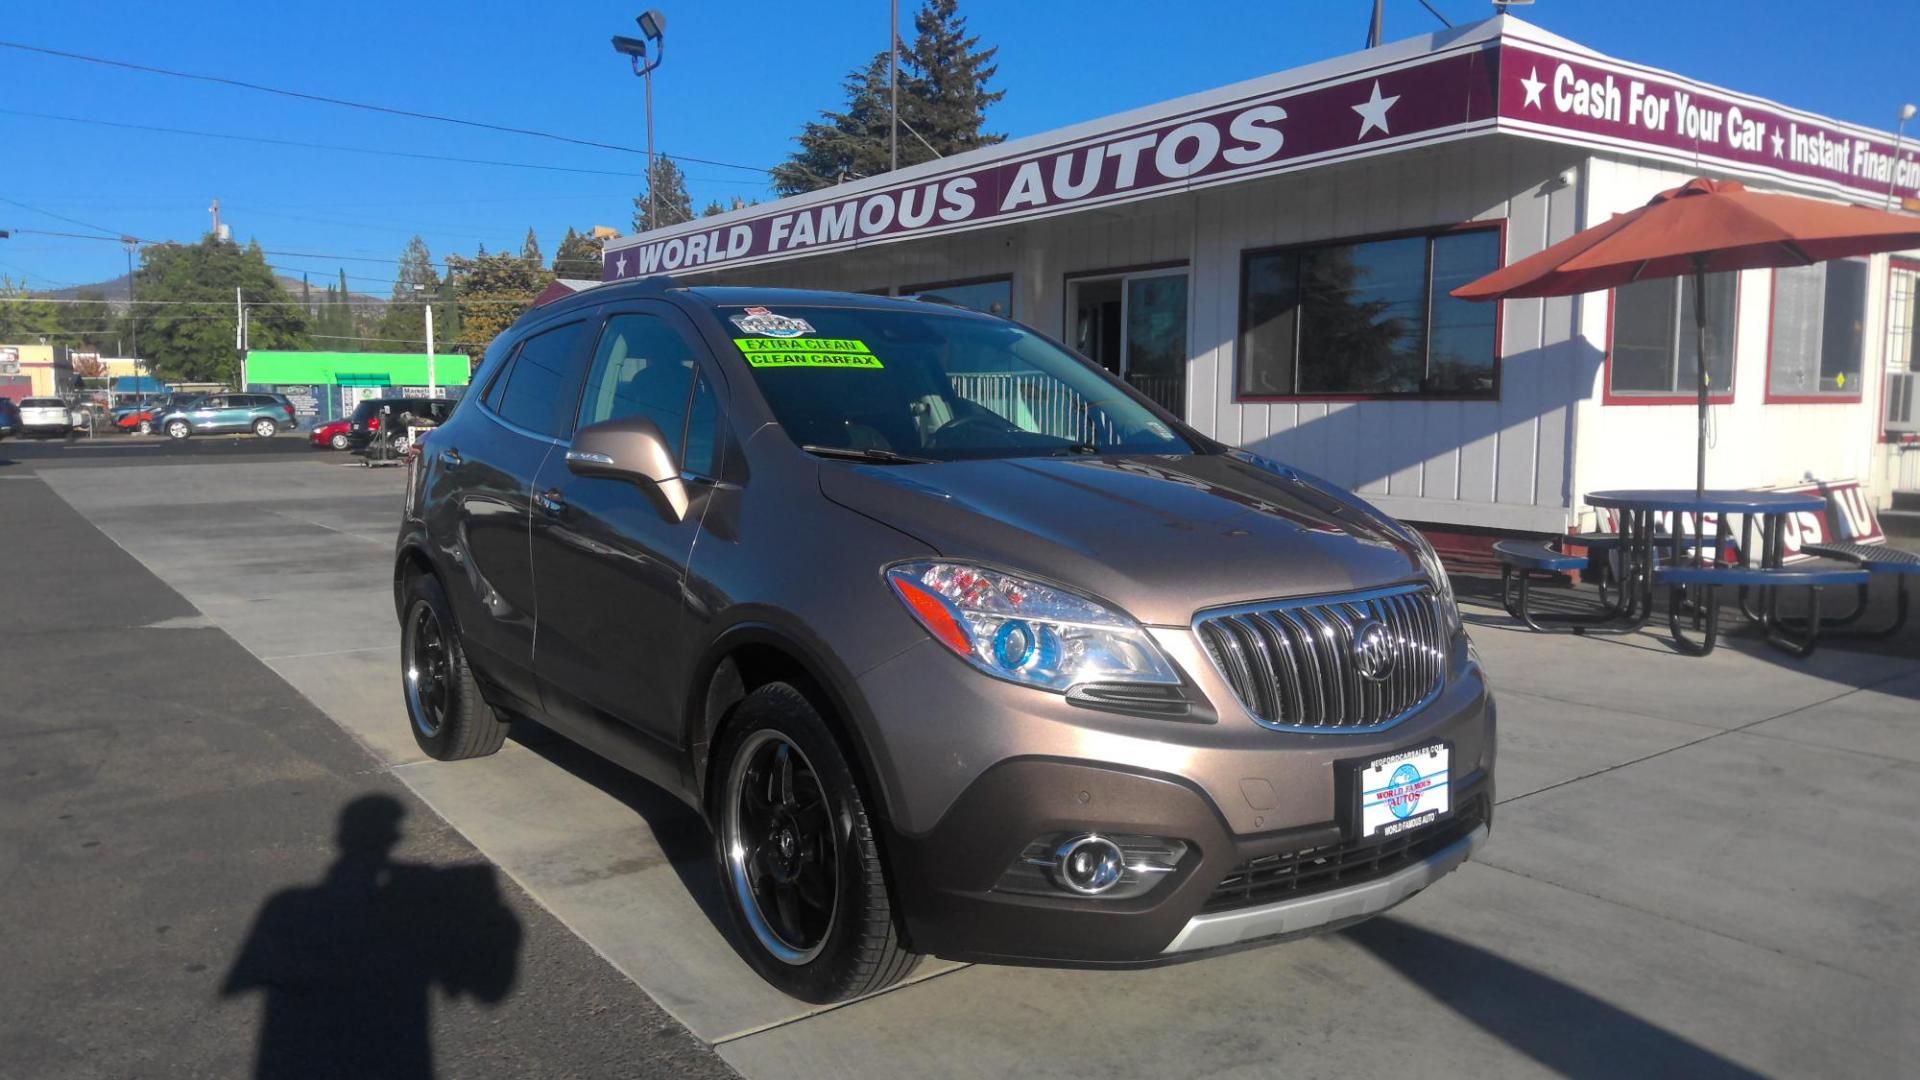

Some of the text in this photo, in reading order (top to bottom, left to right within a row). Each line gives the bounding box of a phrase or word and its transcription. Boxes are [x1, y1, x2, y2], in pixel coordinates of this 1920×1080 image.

[1553, 63, 1621, 122] Cash
[1628, 80, 1670, 130] For
[1674, 90, 1722, 143] Your
[1727, 106, 1765, 152] Car
[1790, 123, 1850, 174] Instant
[638, 105, 1288, 274] WORLD FAMOUS AUTOS
[745, 339, 857, 350] EXTRA CLEAN
[751, 354, 873, 365] CLEAN CARFAX
[1376, 780, 1431, 800] WORLD FAMOUS
[1390, 791, 1421, 806] AUTOS
[1384, 823, 1403, 836] WORLD
[1403, 817, 1422, 830] FAMOUS
